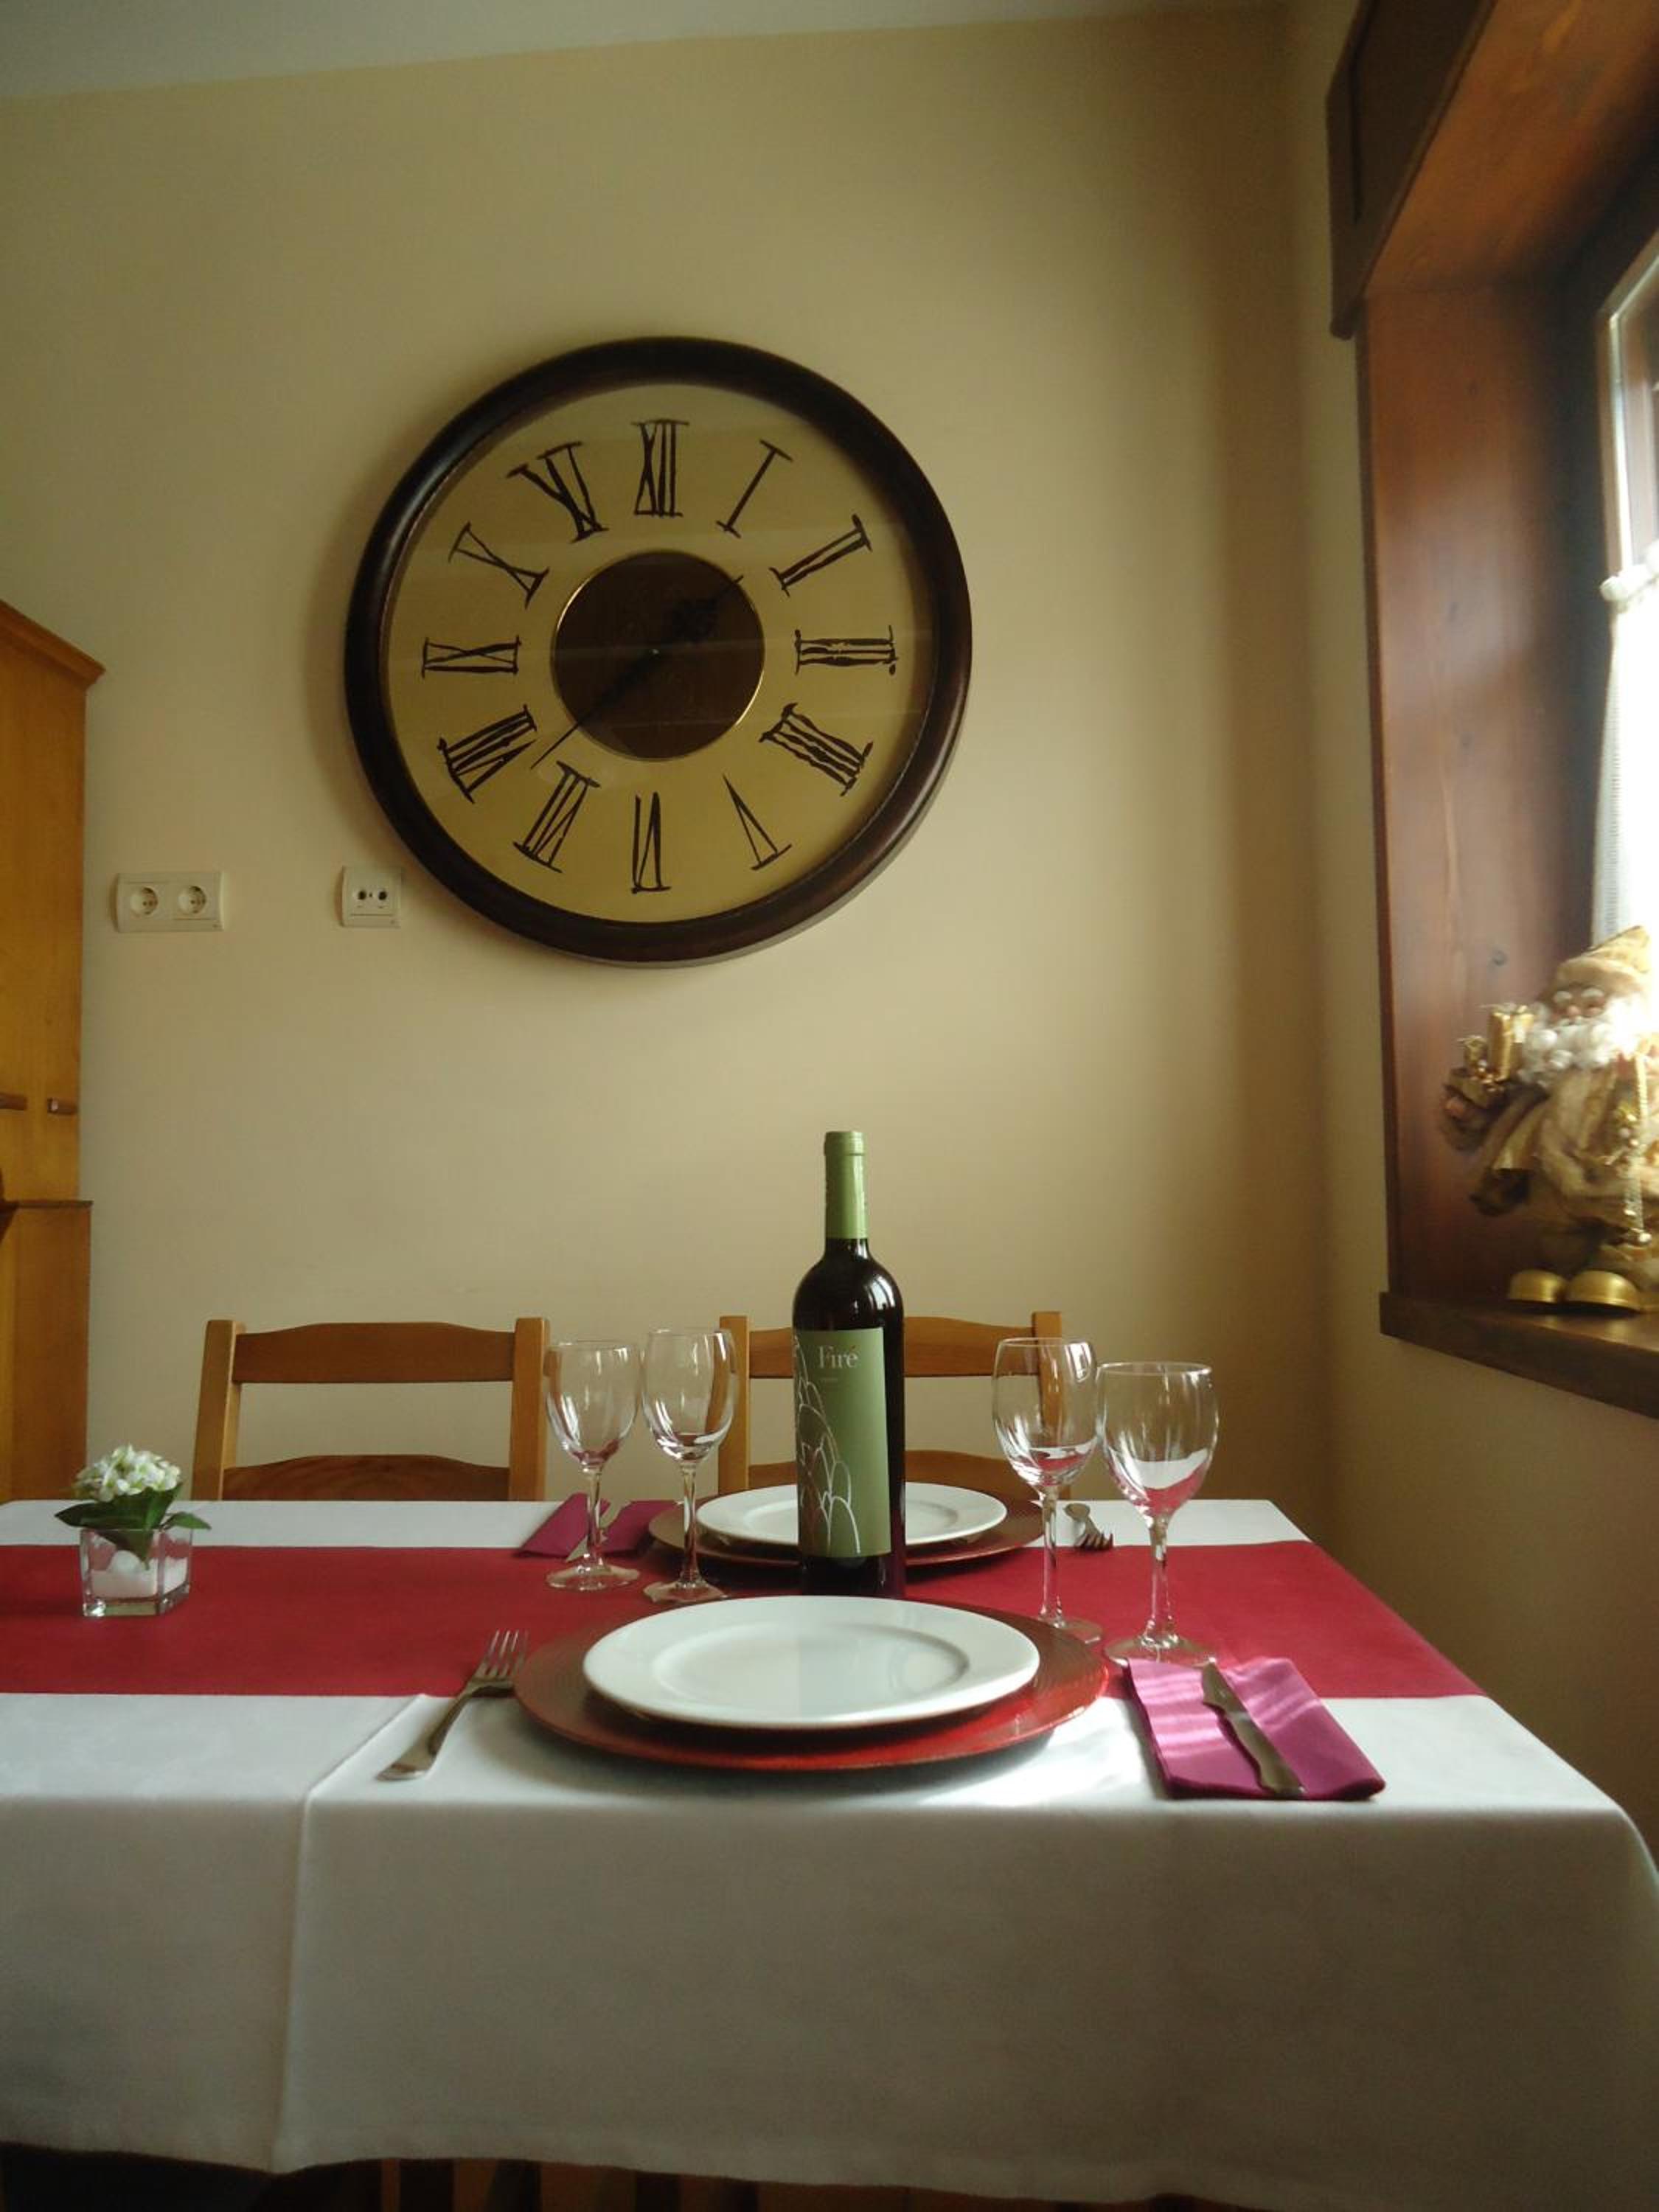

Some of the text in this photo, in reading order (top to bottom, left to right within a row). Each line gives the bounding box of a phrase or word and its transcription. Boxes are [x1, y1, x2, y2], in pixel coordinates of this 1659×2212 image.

[507, 441, 608, 543] XI
[631, 419, 689, 518] XII
[716, 440, 792, 538] I
[448, 522, 549, 608] X
[768, 514, 872, 597] II
[422, 636, 521, 678] IX
[795, 625, 897, 675] III
[437, 703, 538, 804] VIII
[513, 761, 600, 873] VII
[631, 792, 672, 894] VI
[723, 775, 792, 870] V
